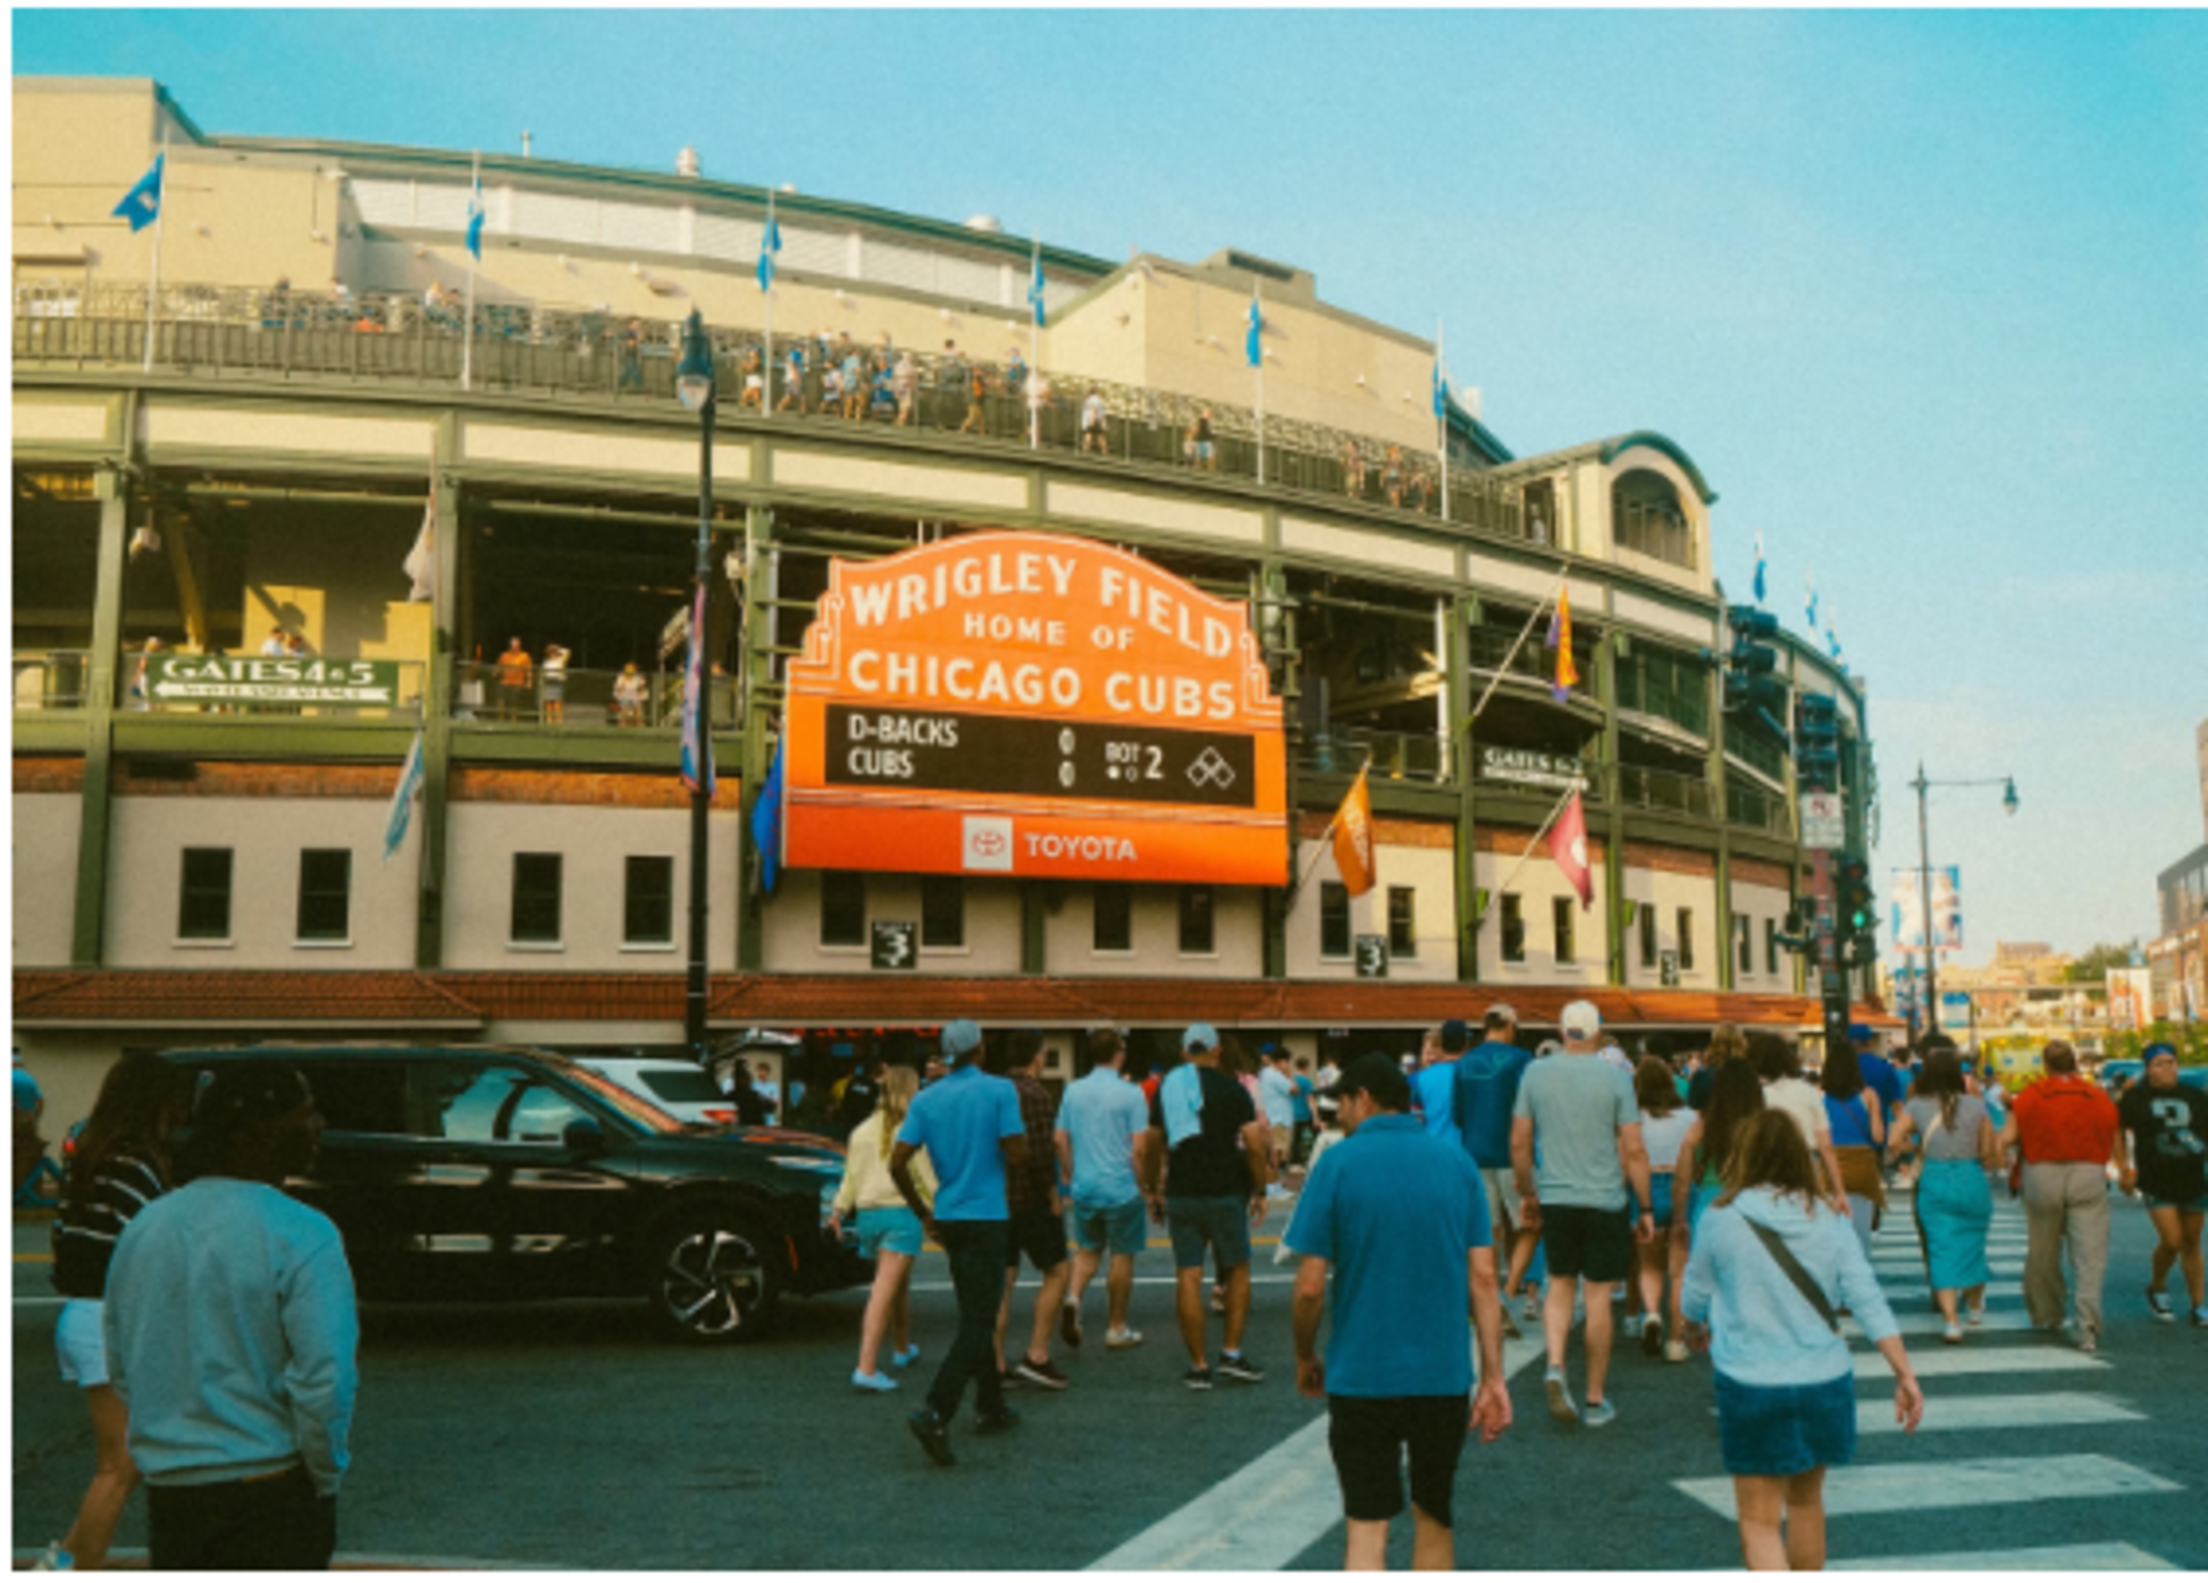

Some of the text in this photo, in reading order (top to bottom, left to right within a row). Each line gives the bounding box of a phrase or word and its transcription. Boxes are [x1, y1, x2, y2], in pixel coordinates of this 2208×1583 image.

[850, 552, 1232, 658] WRIGLEY FIELD
[964, 613, 1135, 651] HOME OF
[163, 659, 301, 681] GATES
[848, 650, 1235, 719] CHICAGO CUBS
[847, 713, 959, 747] D-BACKS
[847, 748, 914, 778] CUBS
[1106, 742, 1164, 779] BOT 2
[1024, 832, 1138, 861] TOYOTA
